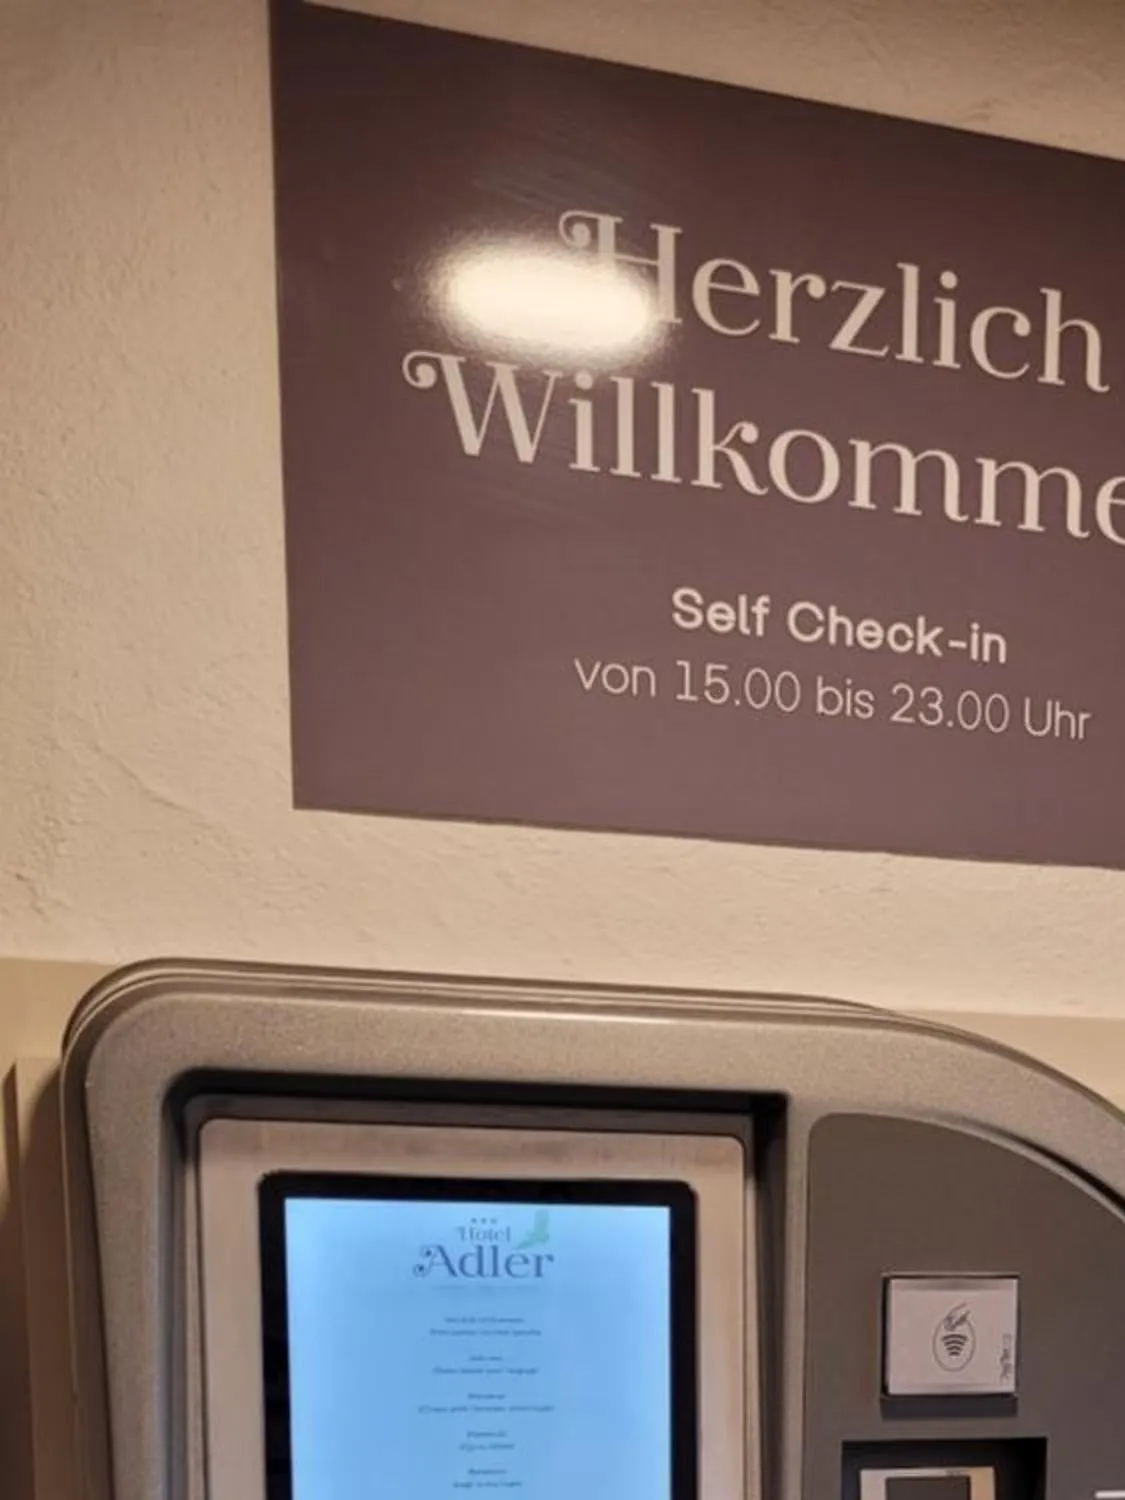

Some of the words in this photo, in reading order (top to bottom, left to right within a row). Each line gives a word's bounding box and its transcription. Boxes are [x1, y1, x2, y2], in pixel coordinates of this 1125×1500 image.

[558, 209, 1110, 393] Herzlich
[671, 587, 771, 638] Self
[786, 600, 1008, 665] Check-in
[573, 656, 658, 698] von
[675, 659, 802, 713] 15.00
[816, 675, 876, 720] bis
[890, 681, 1010, 735] 23.00
[1024, 695, 1094, 741] Uhr
[412, 1244, 555, 1278] Adler
[455, 1225, 511, 1242] Hotel
